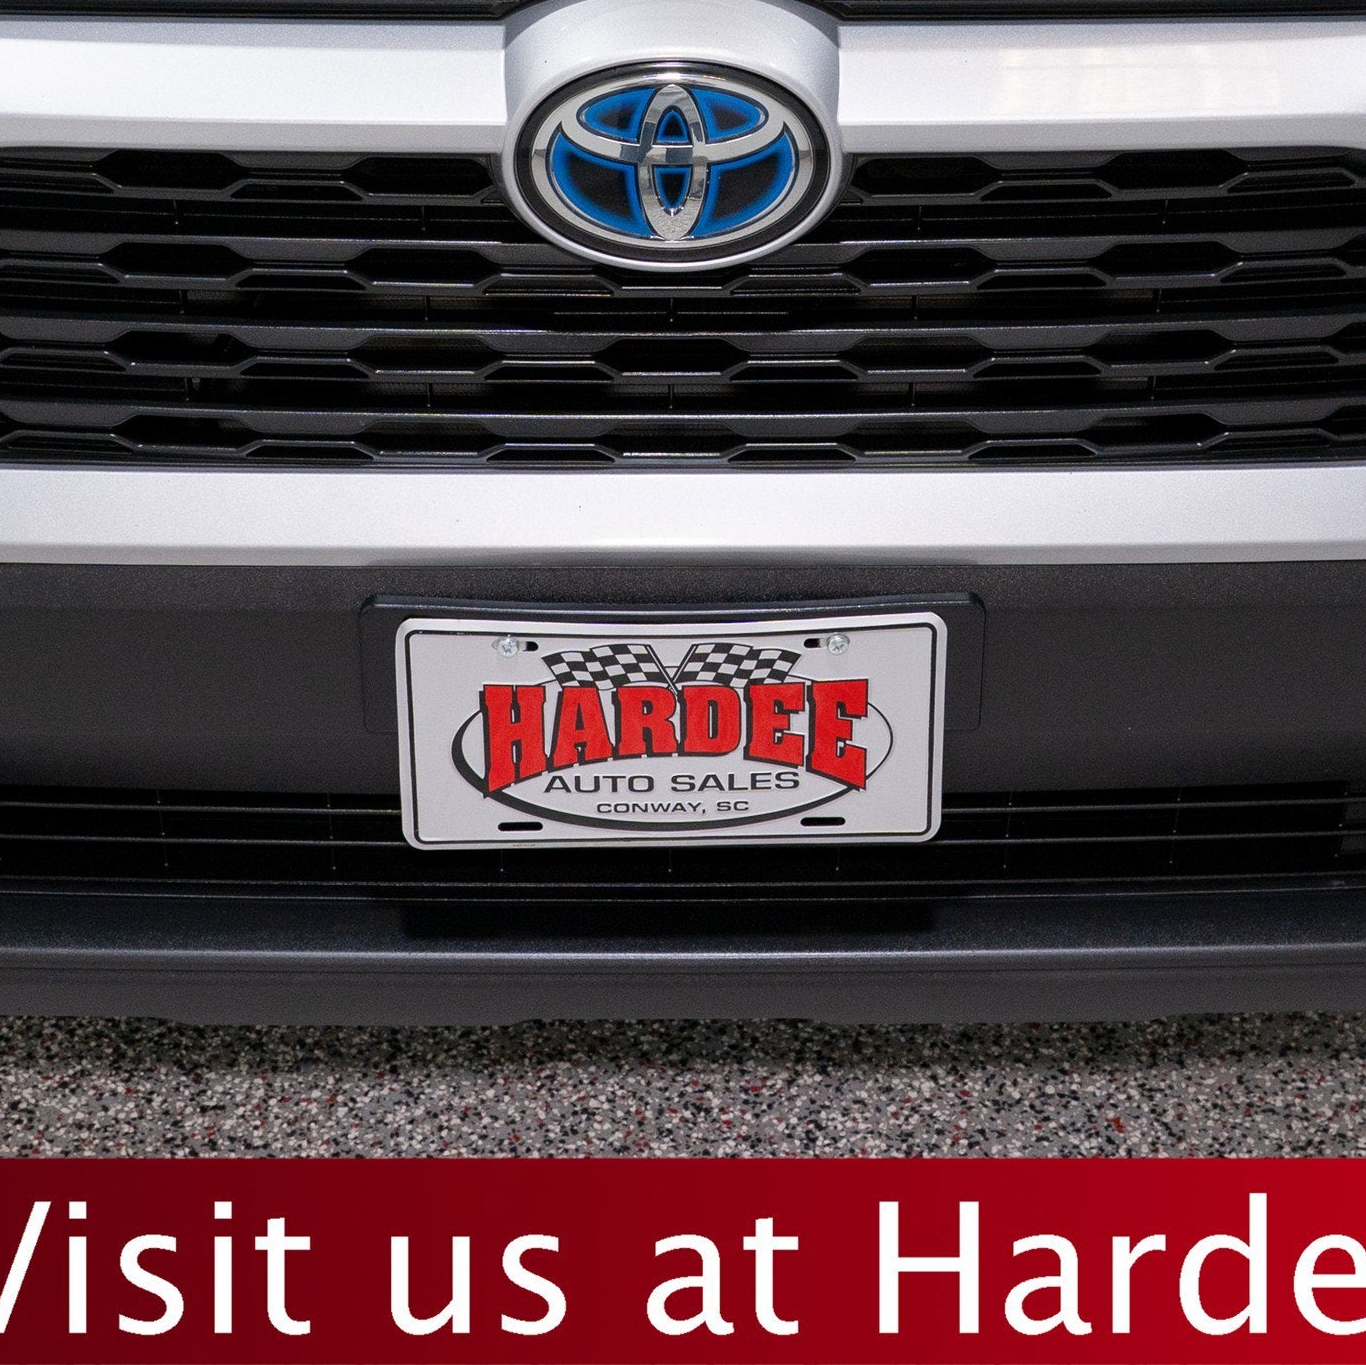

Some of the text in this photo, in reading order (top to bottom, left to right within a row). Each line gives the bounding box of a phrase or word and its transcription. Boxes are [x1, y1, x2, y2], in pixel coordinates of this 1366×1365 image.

[479, 678, 868, 798] HARDEE
[542, 770, 801, 794] AUTO SALES
[596, 799, 749, 814] CONWAY, SC
